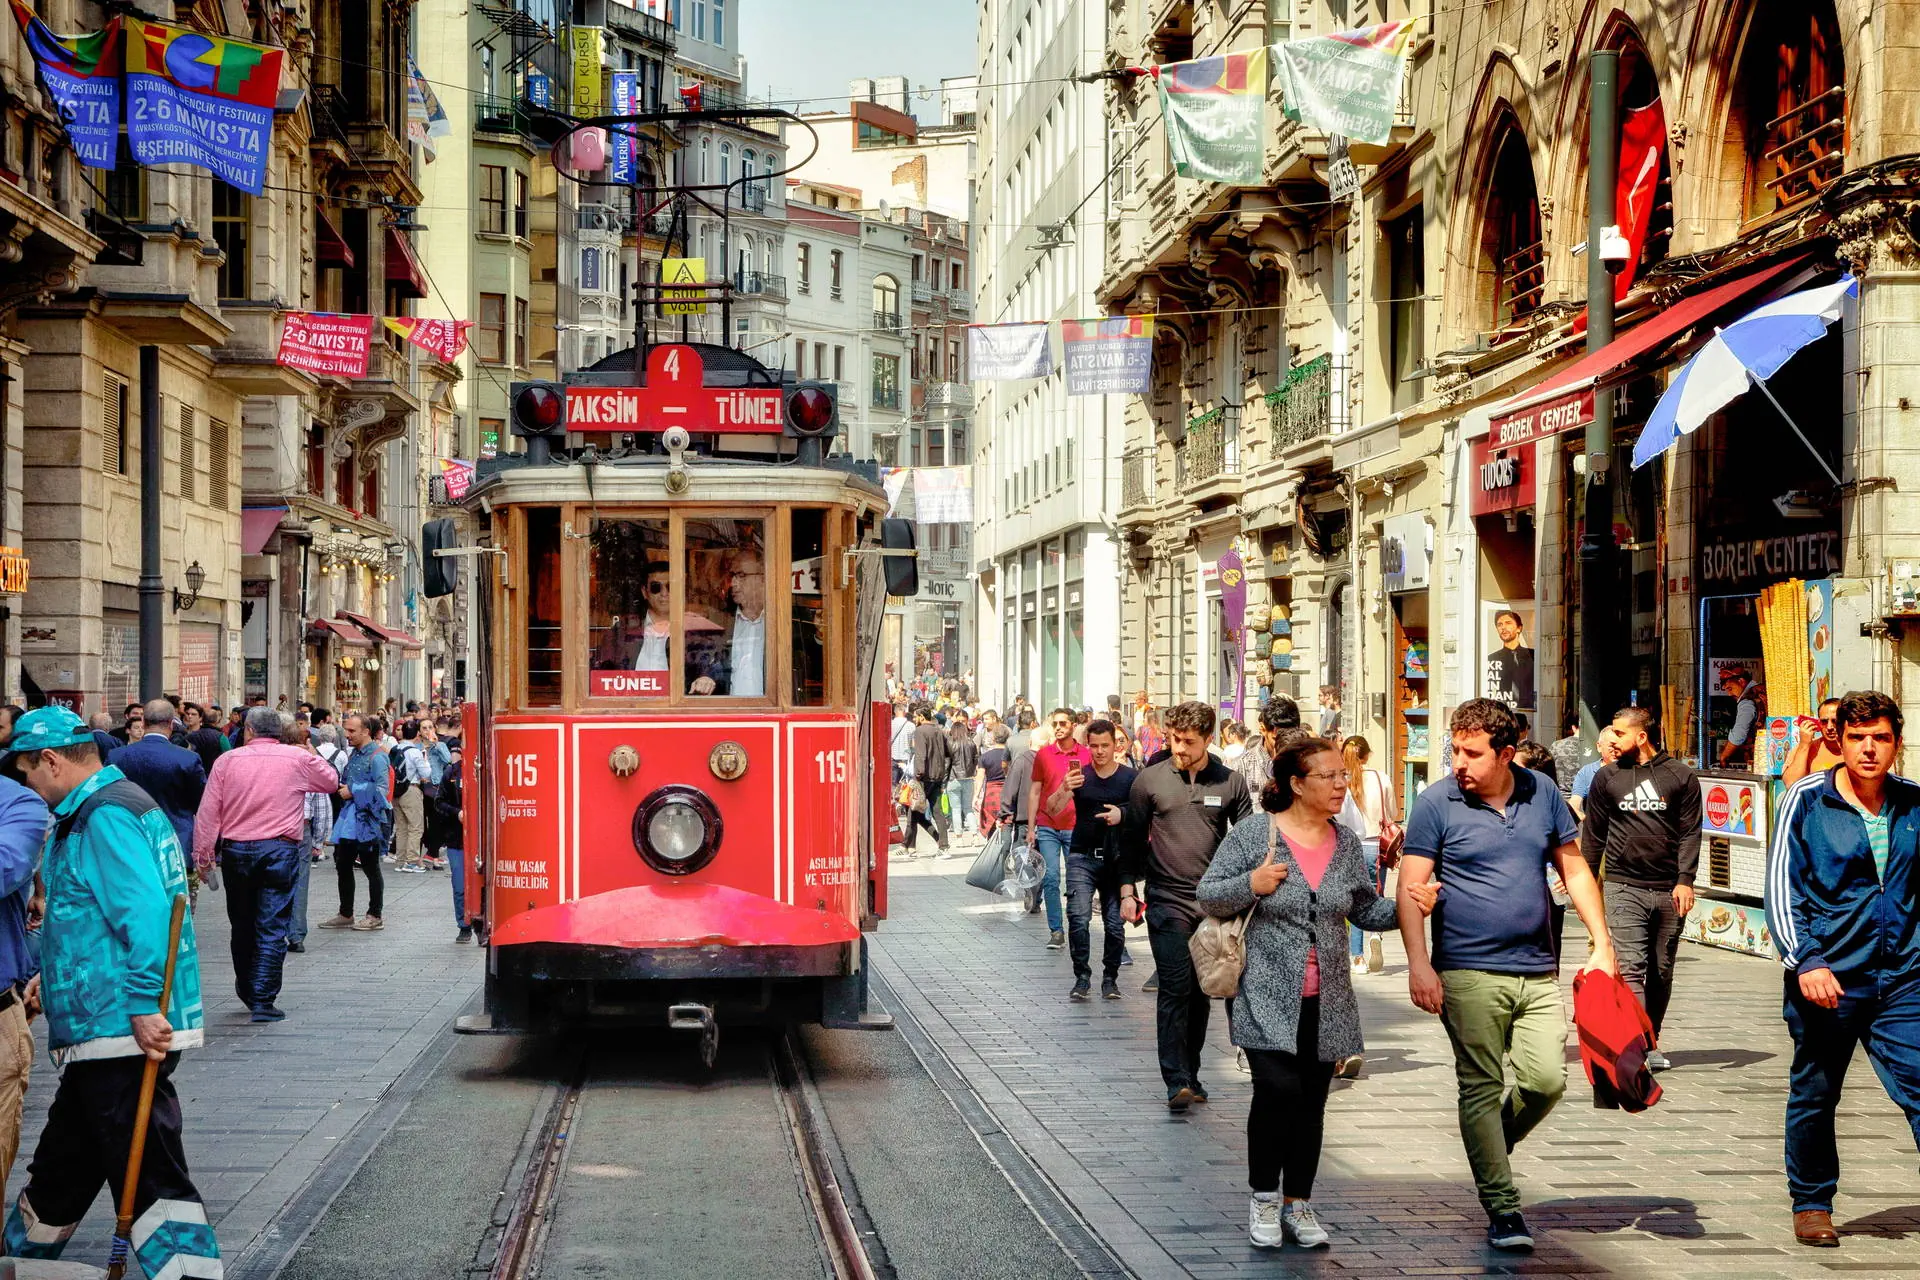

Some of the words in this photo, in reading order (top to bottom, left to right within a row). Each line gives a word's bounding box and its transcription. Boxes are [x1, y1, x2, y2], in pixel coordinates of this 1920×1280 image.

[579, 31, 589, 76] KURSU
[133, 79, 178, 99] İSTANBUL
[178, 92, 215, 114] GENÇLİK
[218, 105, 266, 125] FESTİVALİ
[135, 97, 171, 120] 2-6
[175, 103, 260, 153] MAYIS'TA
[135, 123, 163, 133] AVRASYA
[136, 139, 257, 188] #ŞEHRİNFESTİVALİ
[670, 303, 698, 312] VOLT
[672, 290, 697, 299] 600
[284, 326, 307, 343] 2-6
[308, 332, 365, 352] MAYIS'TA
[338, 325, 368, 335] FESTİVALİ
[422, 326, 443, 348] 2-6
[663, 349, 680, 381] 4
[566, 390, 638, 424] TAKSİM
[715, 392, 783, 425] TÜNEL
[1500, 414, 1534, 445] BÖREK
[1540, 399, 1583, 433] CENTER
[1480, 457, 1514, 493] TUDORS
[1703, 536, 1757, 585] BÖREK
[1764, 531, 1832, 574] CENTER
[1487, 660, 1503, 671] KR
[1487, 670, 1502, 681] AL
[601, 675, 662, 690] TÜNEL
[506, 754, 538, 787] 115
[815, 750, 845, 783] 115
[507, 808, 521, 817] ALO
[522, 808, 537, 817] 153
[519, 860, 547, 873] YASAK
[805, 873, 817, 887] VE
